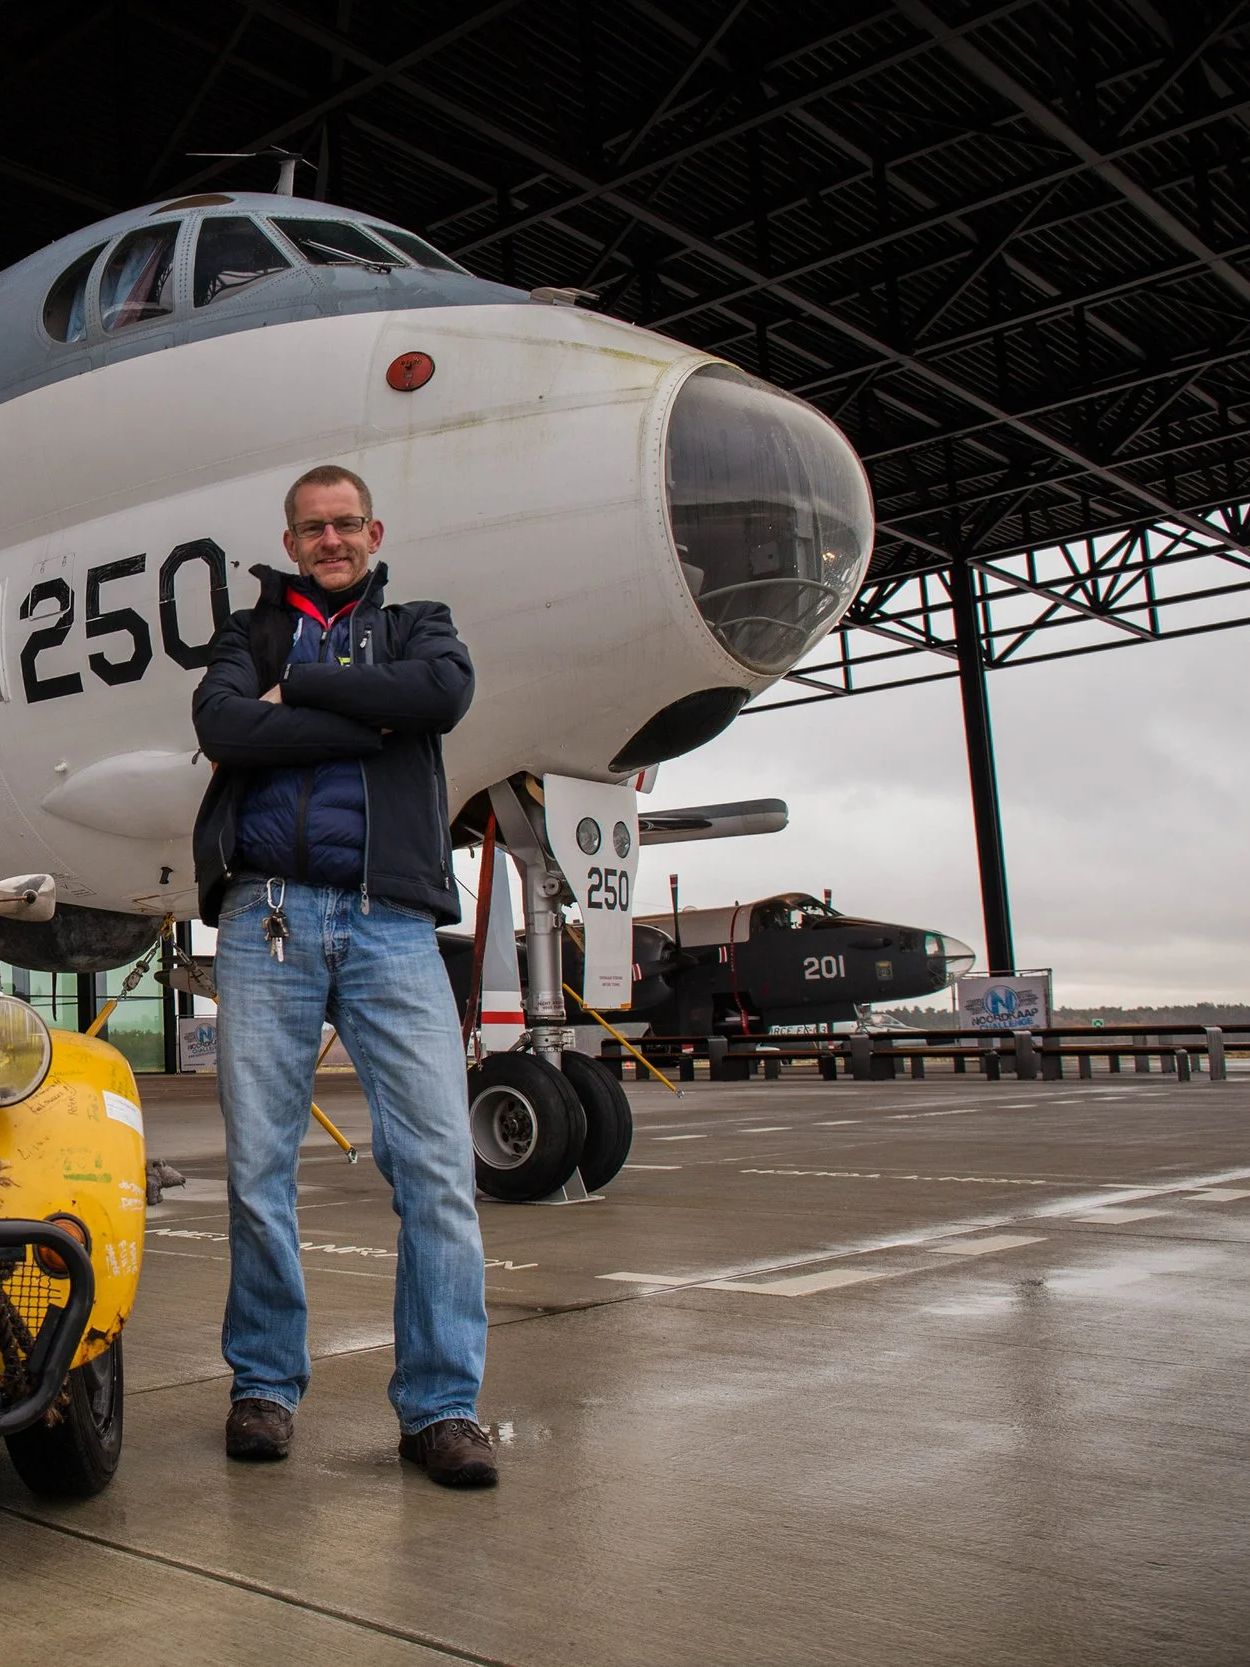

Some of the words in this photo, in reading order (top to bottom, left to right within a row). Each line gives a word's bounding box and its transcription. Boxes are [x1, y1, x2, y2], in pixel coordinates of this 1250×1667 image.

[19, 538, 232, 704] 250
[587, 867, 630, 911] 250
[803, 955, 846, 980] 201
[971, 1008, 1039, 1026] NOORDKAAP
